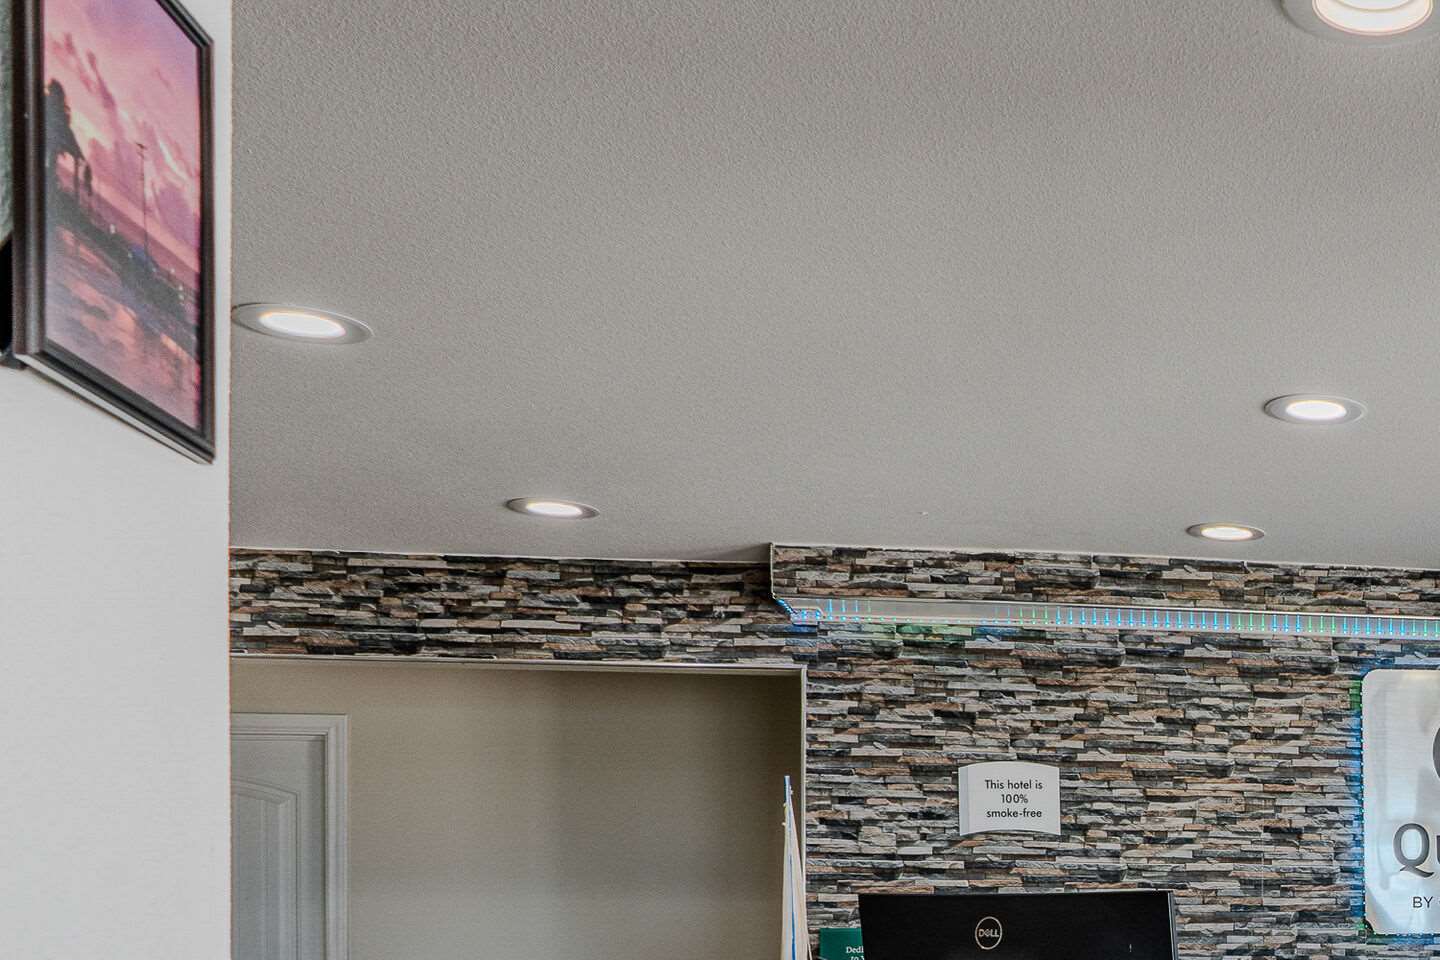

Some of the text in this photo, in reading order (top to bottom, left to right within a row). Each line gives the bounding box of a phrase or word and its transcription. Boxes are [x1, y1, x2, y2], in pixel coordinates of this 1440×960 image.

[985, 779, 1043, 790] This hotel is
[1001, 793, 1029, 804] 100%
[986, 807, 1042, 818] smoke-free
[1412, 896, 1434, 909] BY
[978, 928, 1000, 938] DELL
